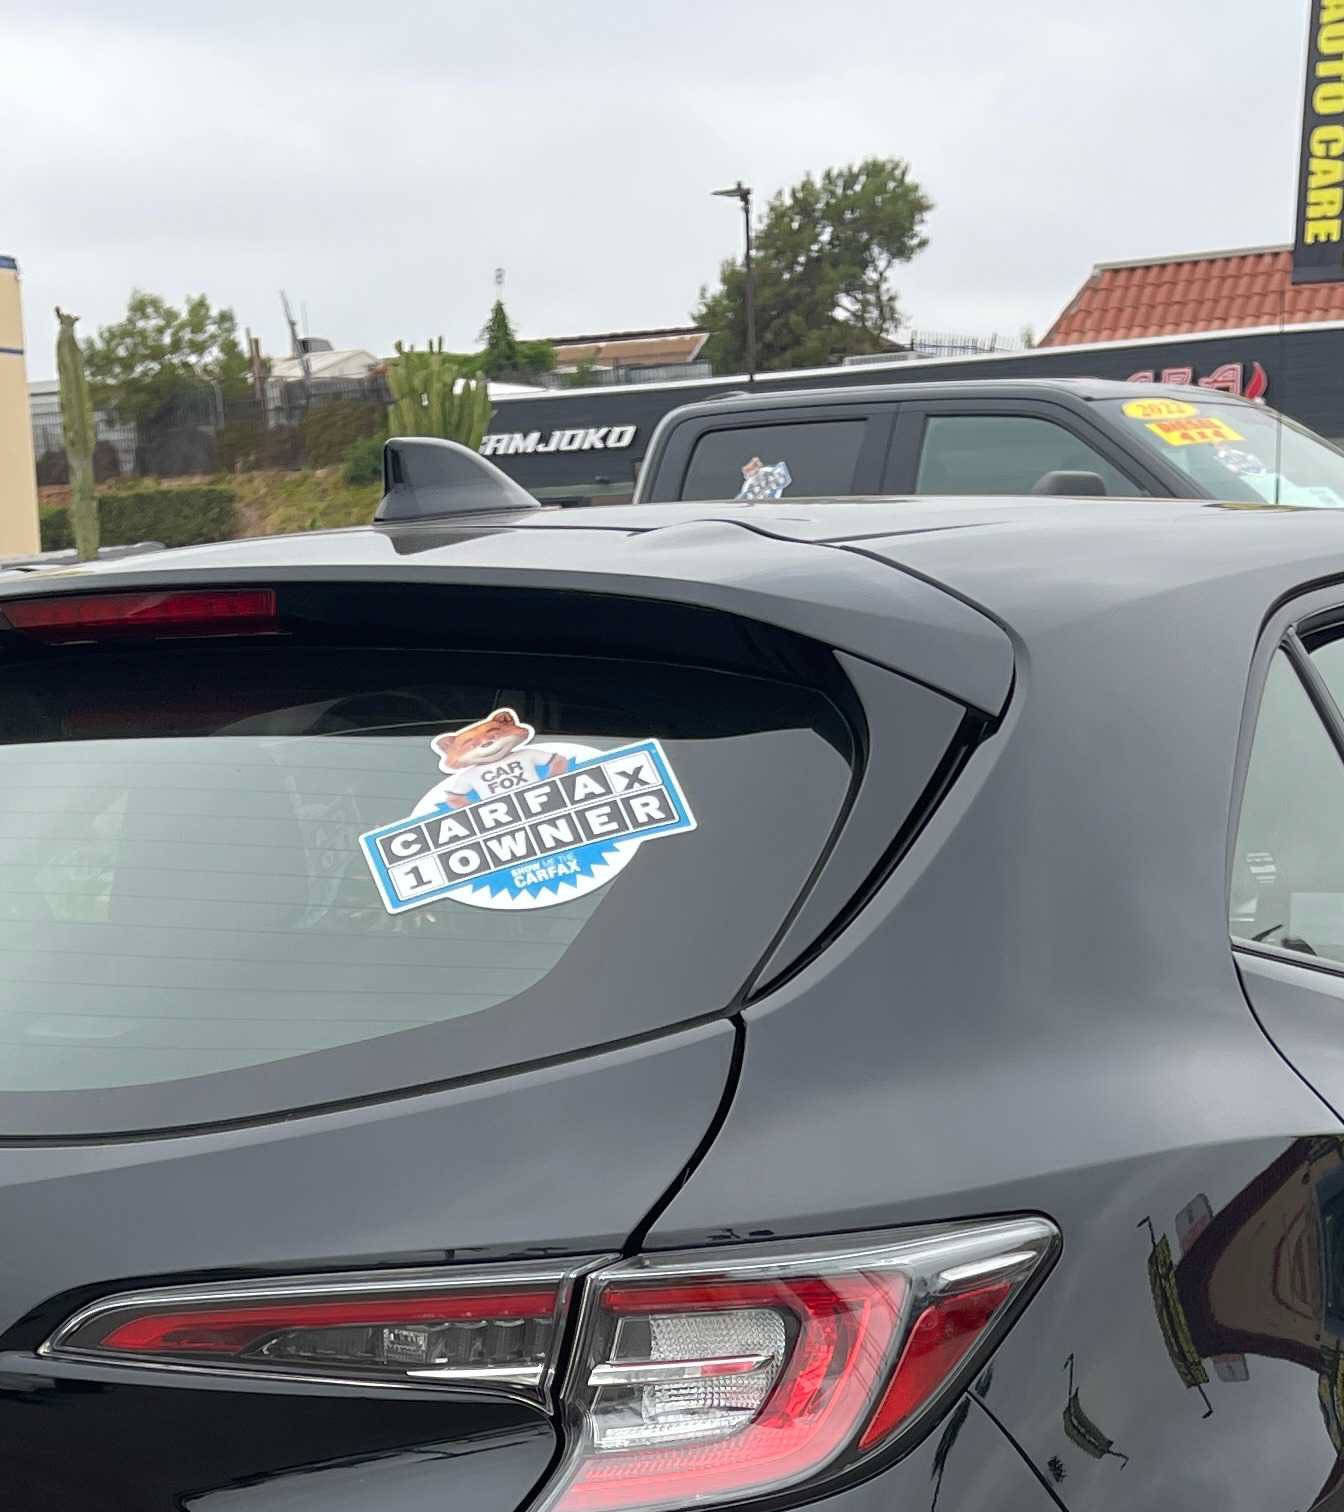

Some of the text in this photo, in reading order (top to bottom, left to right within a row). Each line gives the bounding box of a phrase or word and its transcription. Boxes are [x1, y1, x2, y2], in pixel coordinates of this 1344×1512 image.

[480, 761, 524, 783] CAR
[487, 772, 528, 794] FOX
[388, 765, 651, 859] CARFAX
[409, 795, 667, 891] 1 OWNER
[513, 860, 581, 888] CARFAX
